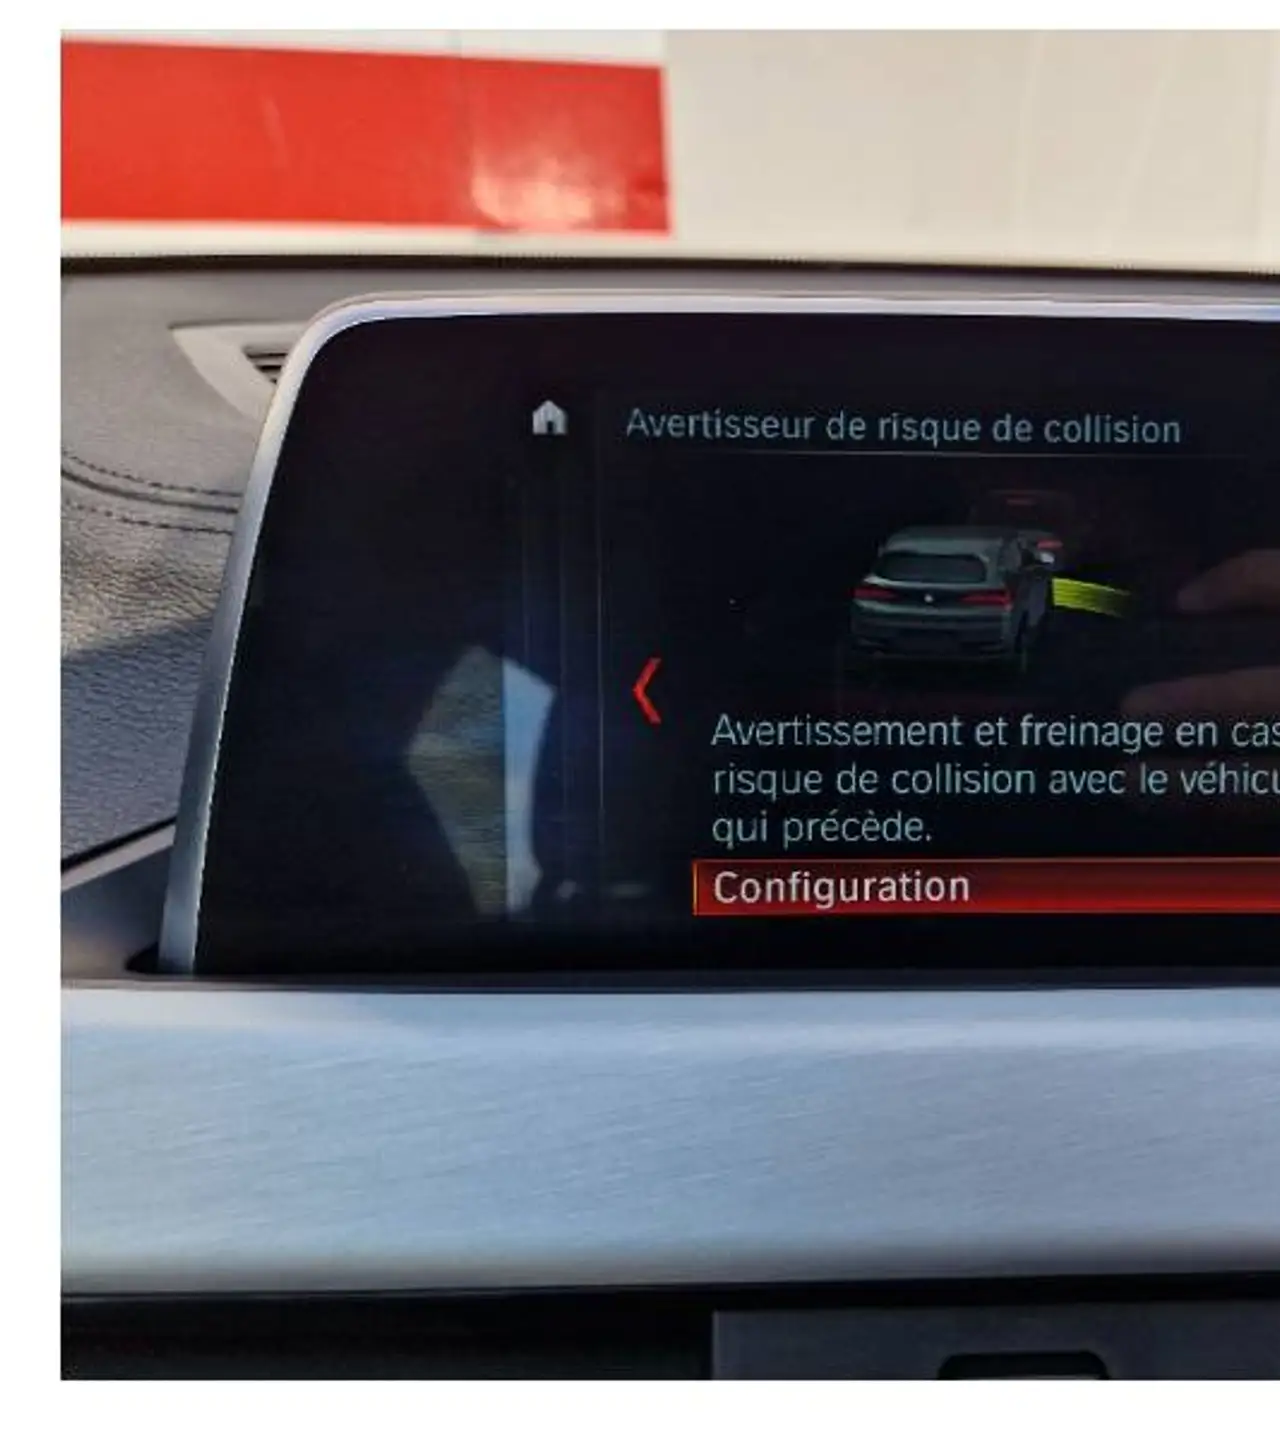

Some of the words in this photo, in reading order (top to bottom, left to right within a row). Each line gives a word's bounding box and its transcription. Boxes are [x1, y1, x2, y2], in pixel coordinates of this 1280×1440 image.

[626, 407, 816, 440] Avertisseur
[826, 410, 867, 441] de
[877, 412, 981, 449] risque
[991, 413, 1034, 442] de
[1043, 413, 1182, 444] collision
[710, 713, 964, 747] Avertissement
[974, 715, 1009, 747] et
[1019, 713, 1164, 755] freinage
[1175, 721, 1219, 748] en
[714, 762, 823, 802] risque
[836, 762, 879, 795] de
[892, 762, 1036, 795] collision
[1049, 769, 1126, 795] avec
[1139, 762, 1169, 795] le
[712, 810, 768, 850] qui
[783, 809, 933, 850] précède.
[714, 870, 970, 910] Configuration
